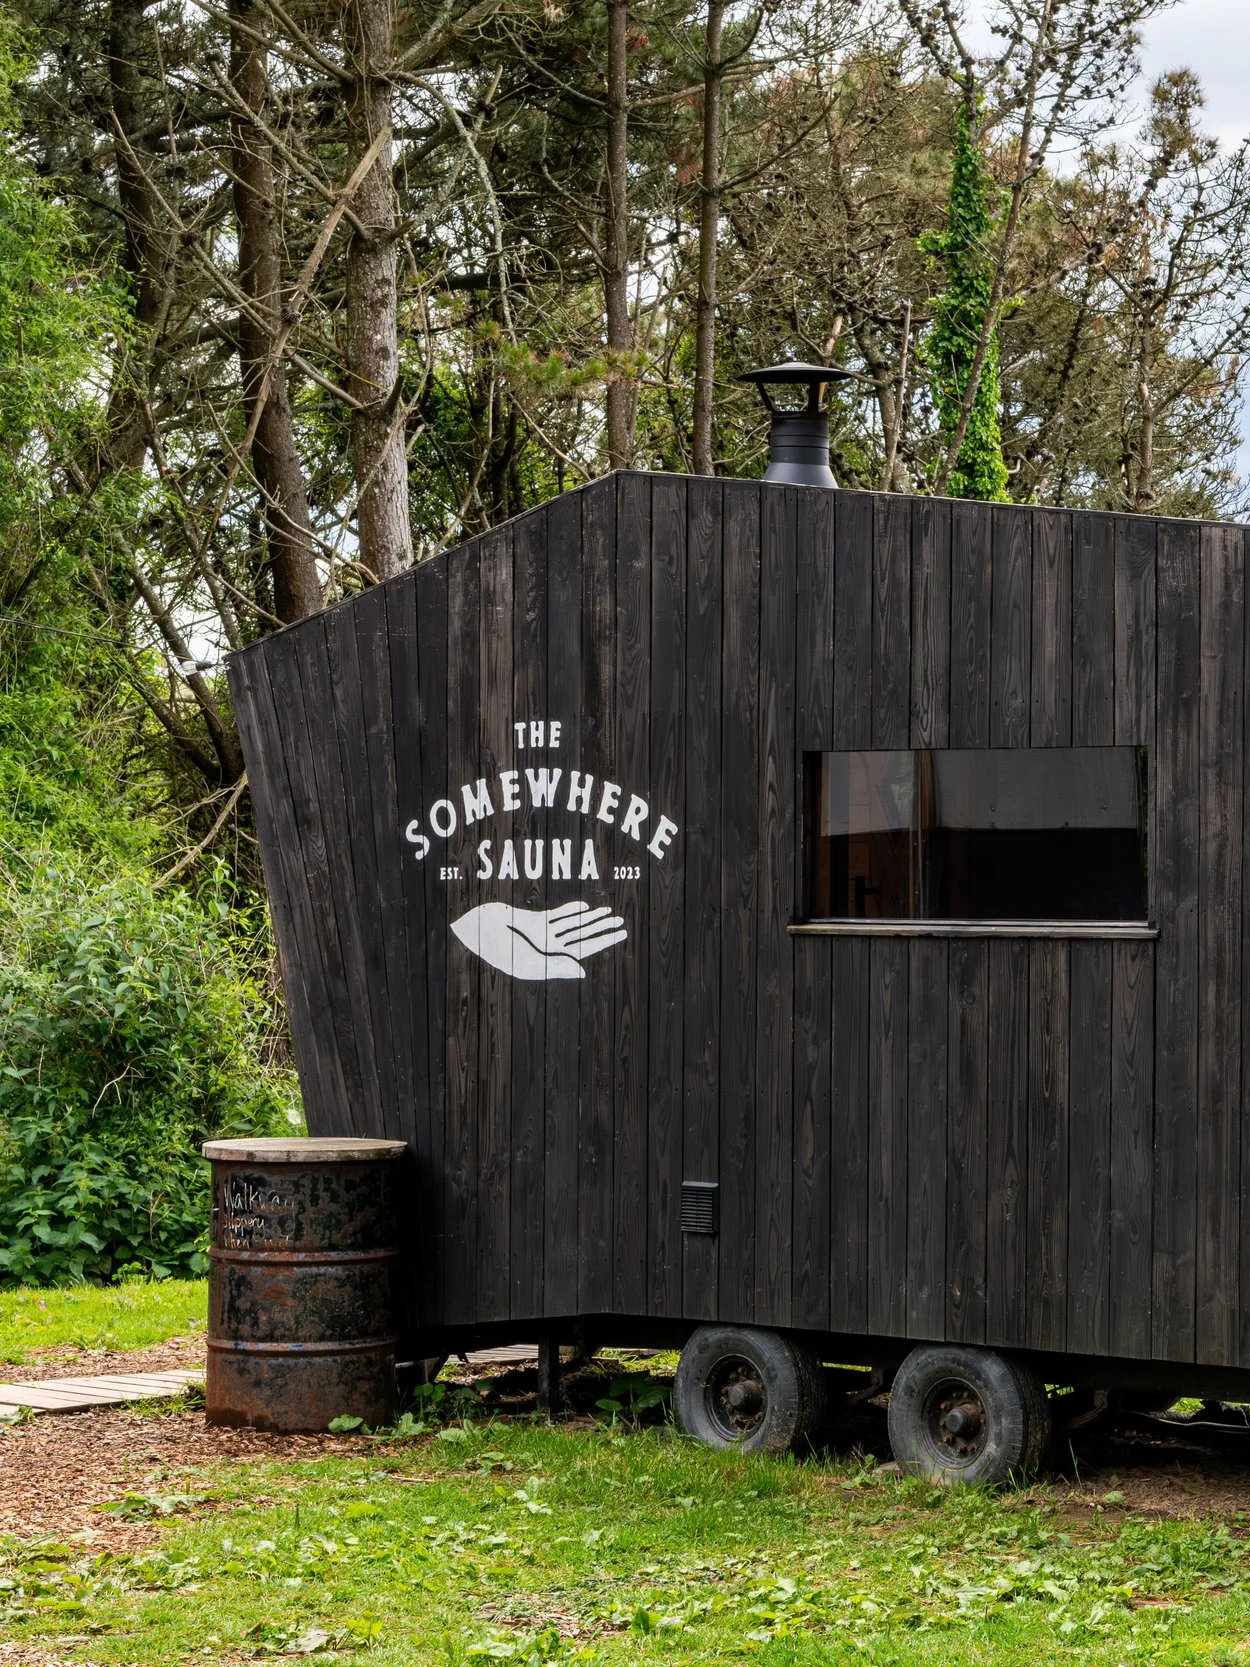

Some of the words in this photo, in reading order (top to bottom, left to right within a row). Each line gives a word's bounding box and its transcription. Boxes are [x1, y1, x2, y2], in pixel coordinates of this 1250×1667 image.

[514, 720, 562, 749] THE
[405, 767, 679, 860] SOMEWHERE
[439, 867, 463, 881] EST.
[476, 838, 600, 881] SAUNA
[613, 866, 641, 880] 2023
